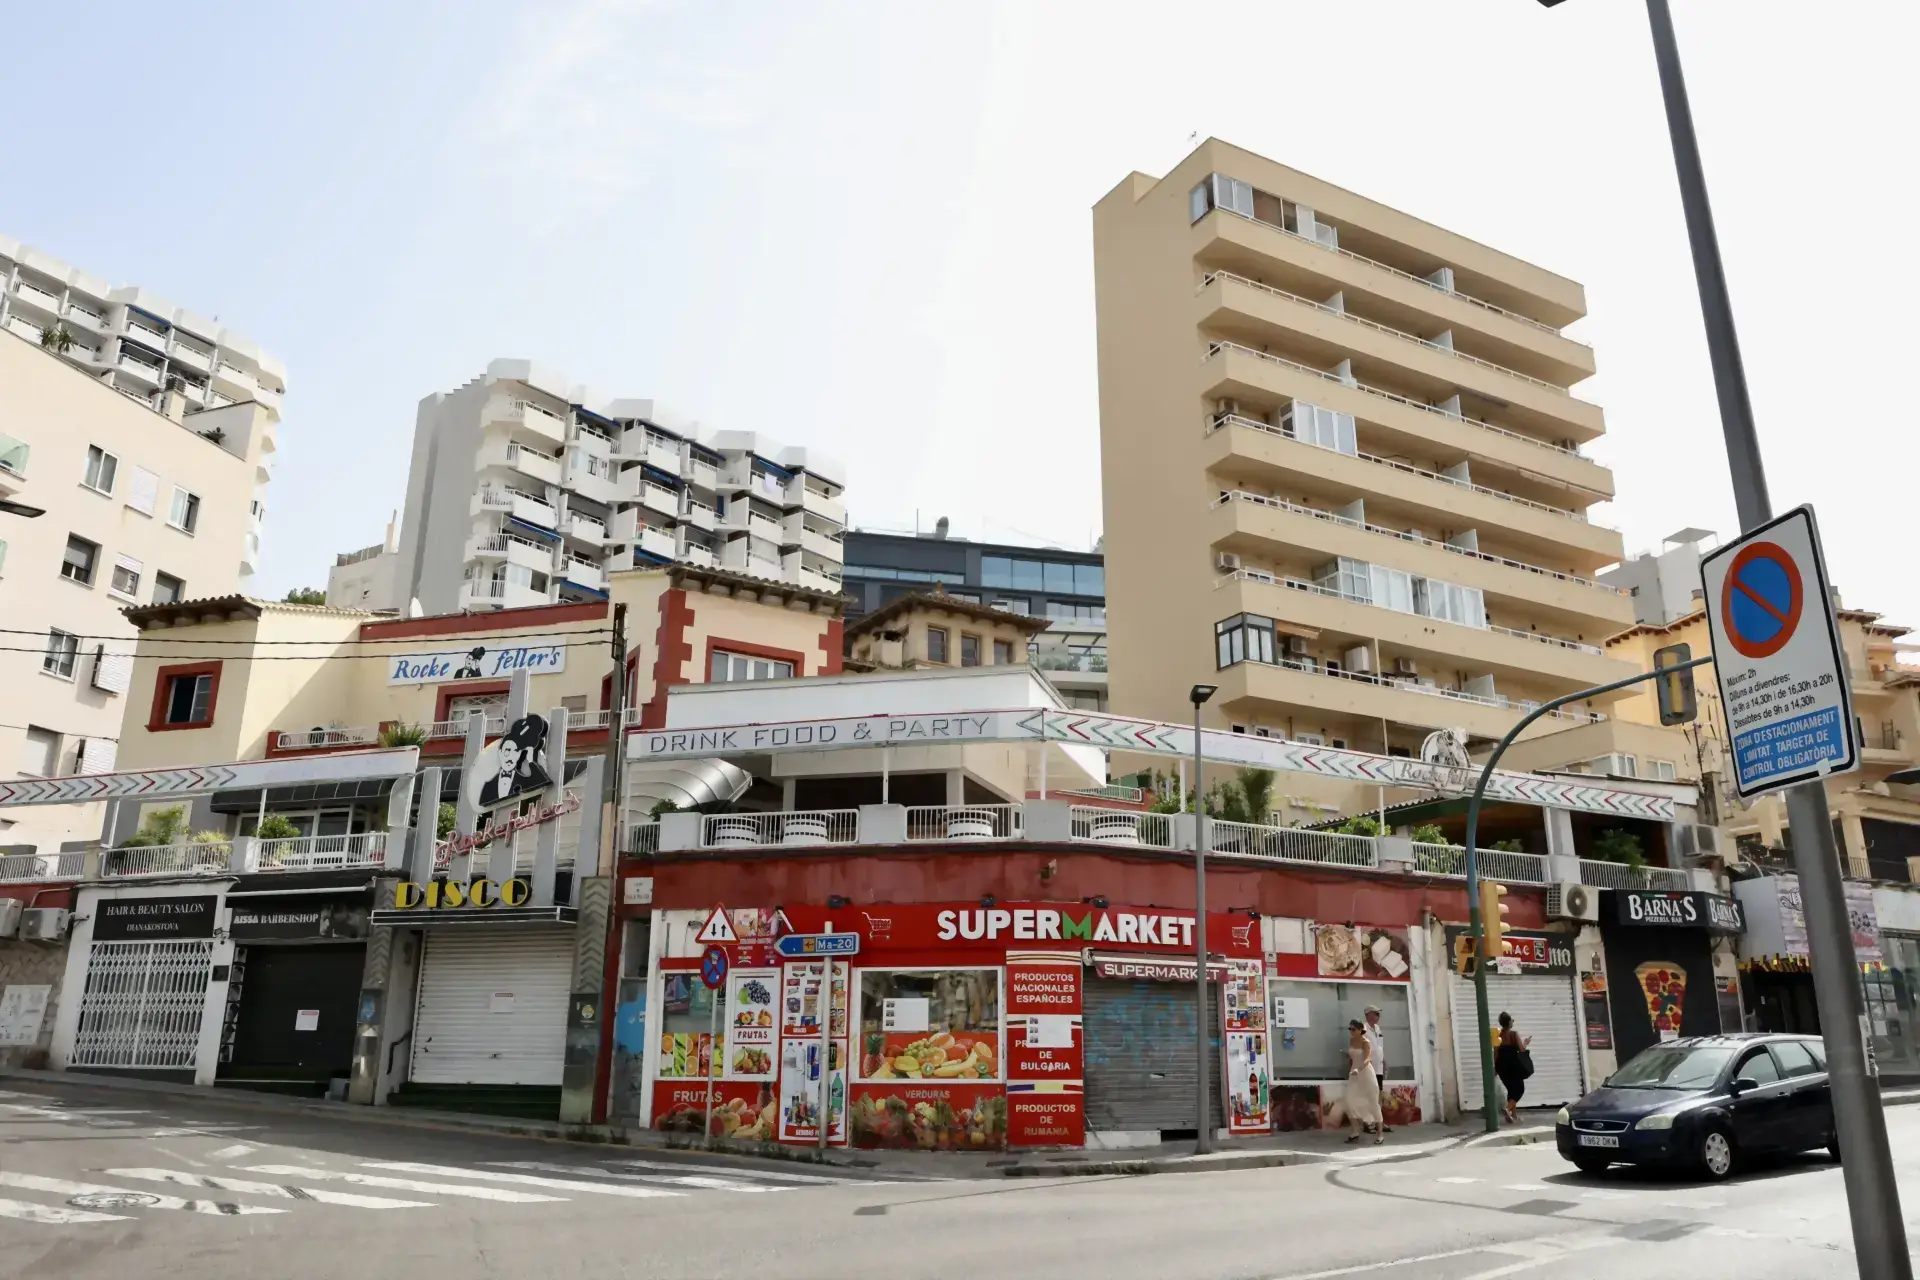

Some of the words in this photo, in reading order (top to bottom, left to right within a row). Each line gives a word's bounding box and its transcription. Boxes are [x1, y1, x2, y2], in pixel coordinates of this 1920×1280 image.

[392, 656, 450, 679] Rocke
[491, 646, 561, 676] feller's
[1748, 668, 1756, 679] 2h
[1729, 687, 1748, 702] Dilluns
[1754, 674, 1791, 692] divendres:
[1732, 707, 1738, 716] de
[1738, 703, 1745, 712] 9h
[1751, 694, 1772, 707] 14,30h
[1778, 688, 1786, 698] de
[1788, 680, 1812, 695] 16,30h
[1819, 673, 1834, 686] 20h
[1734, 712, 1762, 730] Dissabtes
[1763, 708, 1772, 719] de
[1774, 704, 1783, 715] 9h
[1791, 694, 1816, 710] 14,30h
[650, 730, 738, 753] DRINK
[754, 724, 836, 747] FOOD
[852, 722, 872, 740] &
[889, 716, 990, 738] PARTY
[1736, 737, 1752, 750] ZONA
[1744, 745, 1774, 763] LIMITAT.
[1776, 733, 1814, 753] TARGETA
[1816, 729, 1829, 742] DE
[1743, 761, 1775, 780] CONTROL
[1777, 743, 1836, 769] OBLIGATÒRIA
[395, 878, 531, 909] DISCO
[106, 906, 129, 916] HAIR
[130, 905, 136, 915] &
[138, 904, 174, 915] BEAUTY
[174, 903, 204, 914] SALON
[233, 915, 259, 924] AISSA
[261, 914, 319, 924] BARBERSHOP
[937, 909, 1196, 946] SUPERMARKET
[818, 939, 852, 950] Ma-20
[1015, 973, 1074, 982] PRODUCTOS
[1014, 984, 1075, 993] NACIONALES
[1016, 994, 1073, 1004] ESPAÑOLES
[737, 1031, 768, 1039] FRUTAS
[1020, 1062, 1070, 1071] BULGARIA
[905, 1090, 950, 1098] VERDURAS
[1024, 1127, 1069, 1136] RUMANIA
